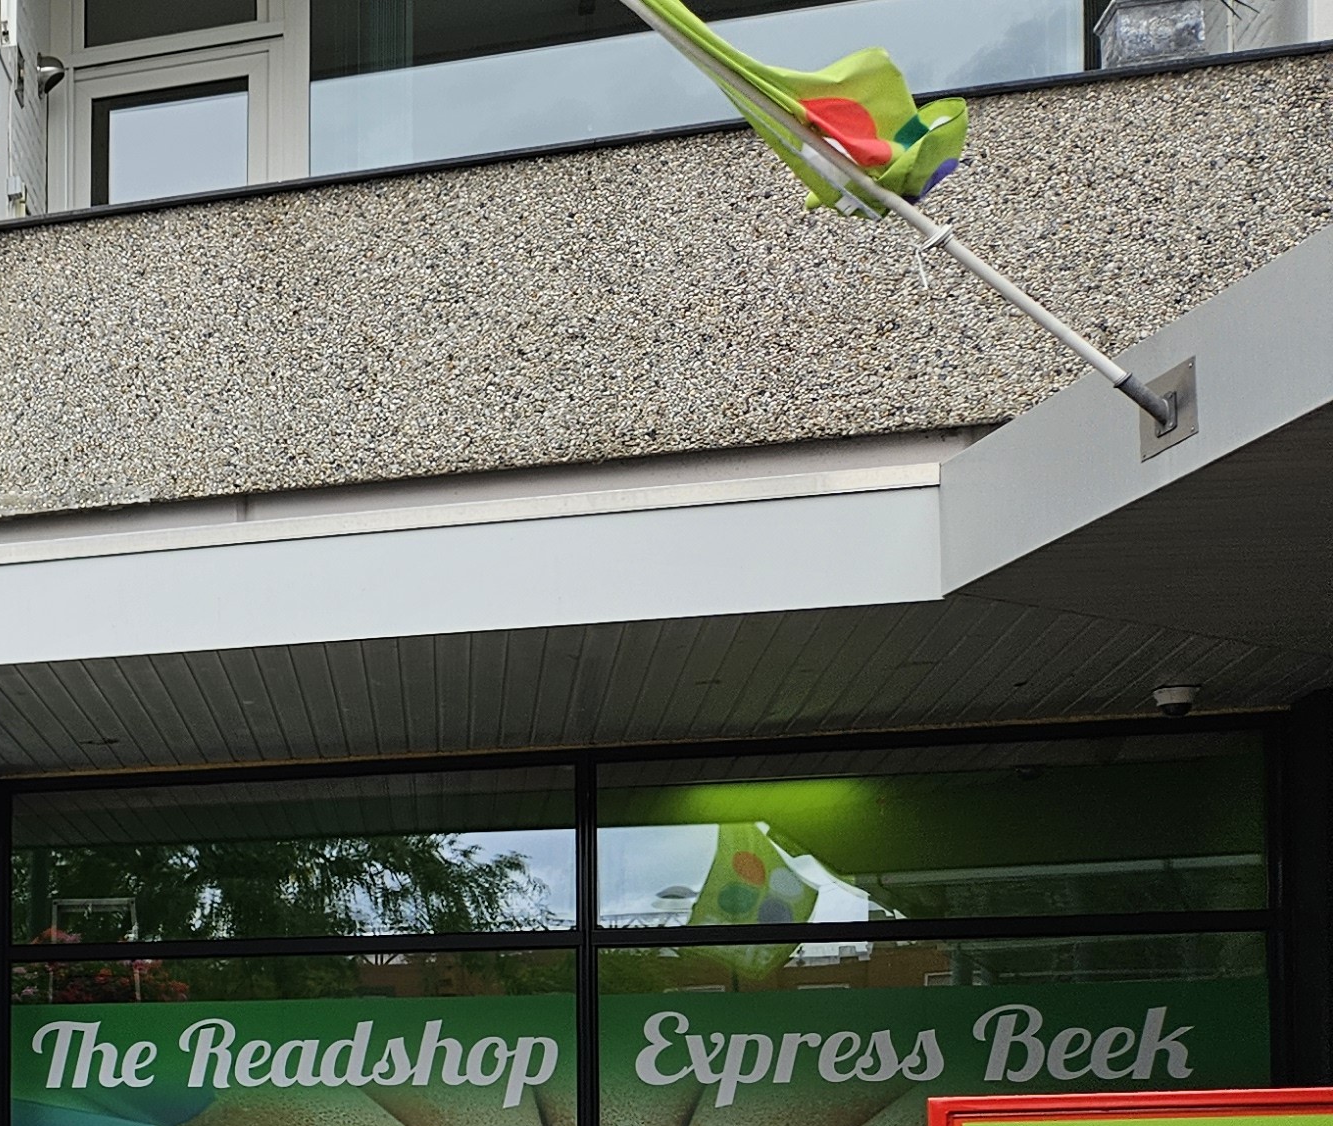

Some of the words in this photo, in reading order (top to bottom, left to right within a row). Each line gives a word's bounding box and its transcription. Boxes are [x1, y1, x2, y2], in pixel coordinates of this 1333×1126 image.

[32, 1020, 158, 1089] The
[178, 1018, 559, 1109] Readshop
[634, 1011, 945, 1108] Express
[972, 1004, 1195, 1082] Beek
